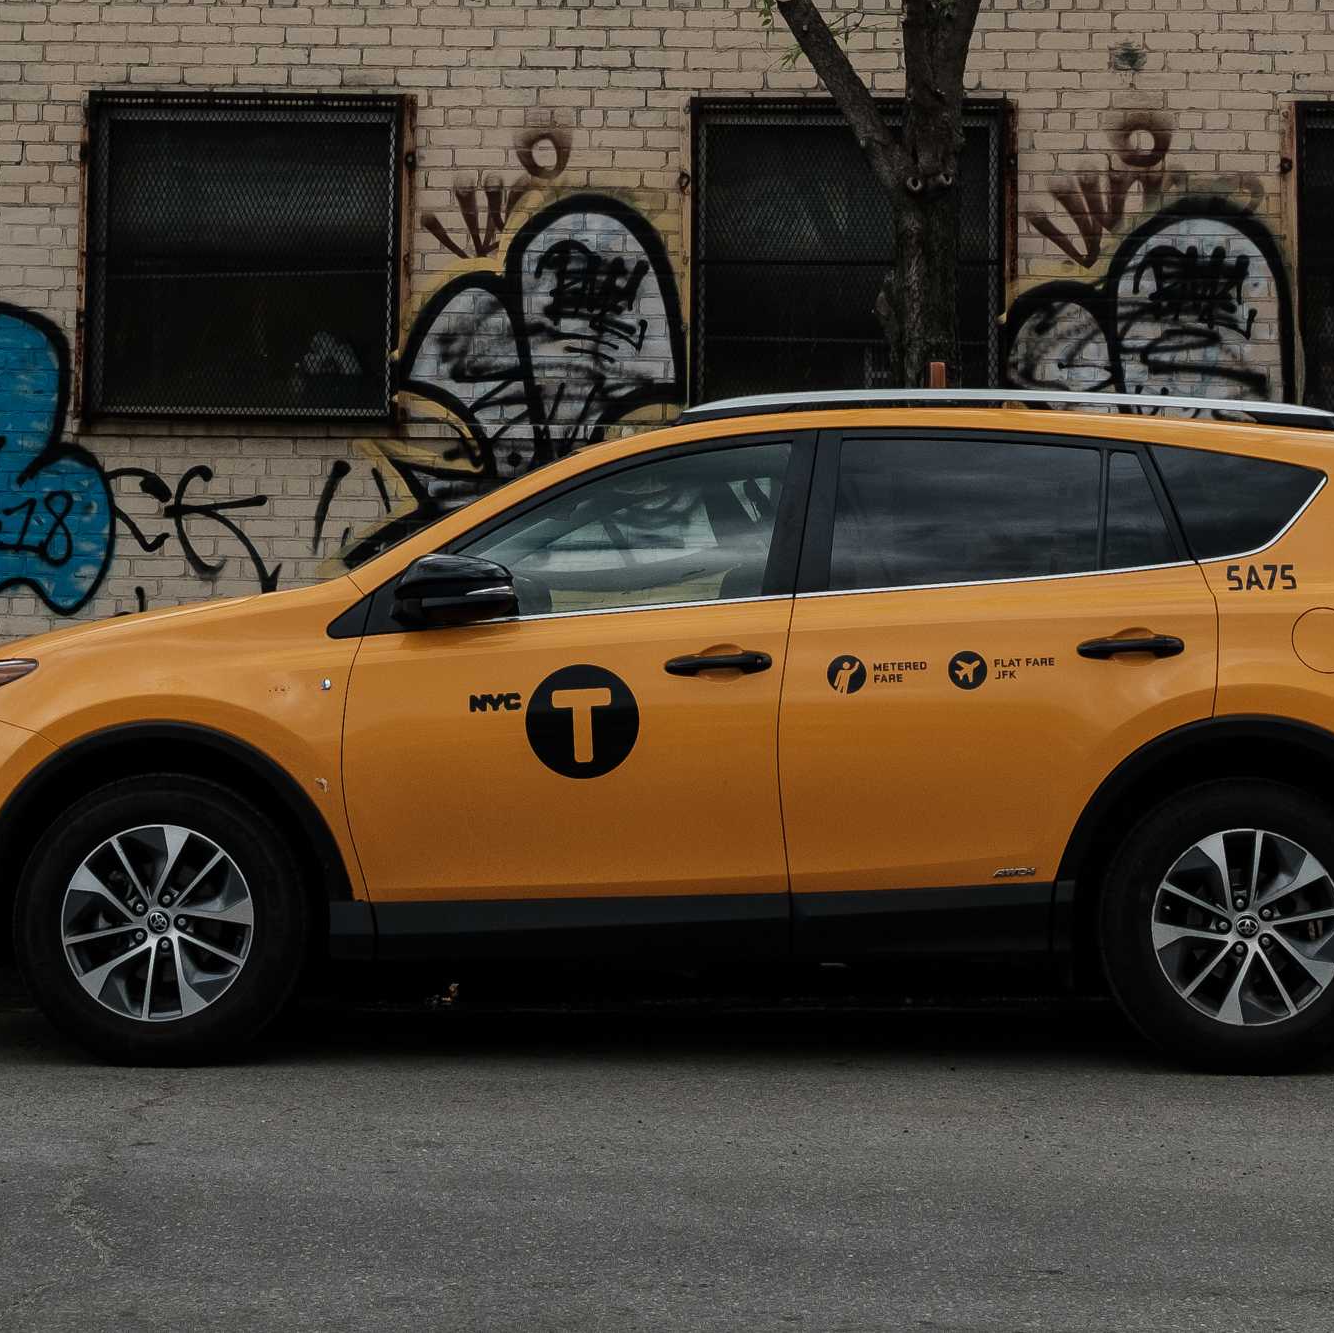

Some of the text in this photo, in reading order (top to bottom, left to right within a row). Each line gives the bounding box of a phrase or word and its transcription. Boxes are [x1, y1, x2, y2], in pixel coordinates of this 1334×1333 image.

[1226, 564, 1297, 591] 5A75
[873, 661, 927, 672] METERED
[994, 657, 1055, 668] FLAT FARE
[873, 673, 903, 683] FARE
[995, 670, 1017, 680] JFK
[469, 687, 612, 763] NYC T
